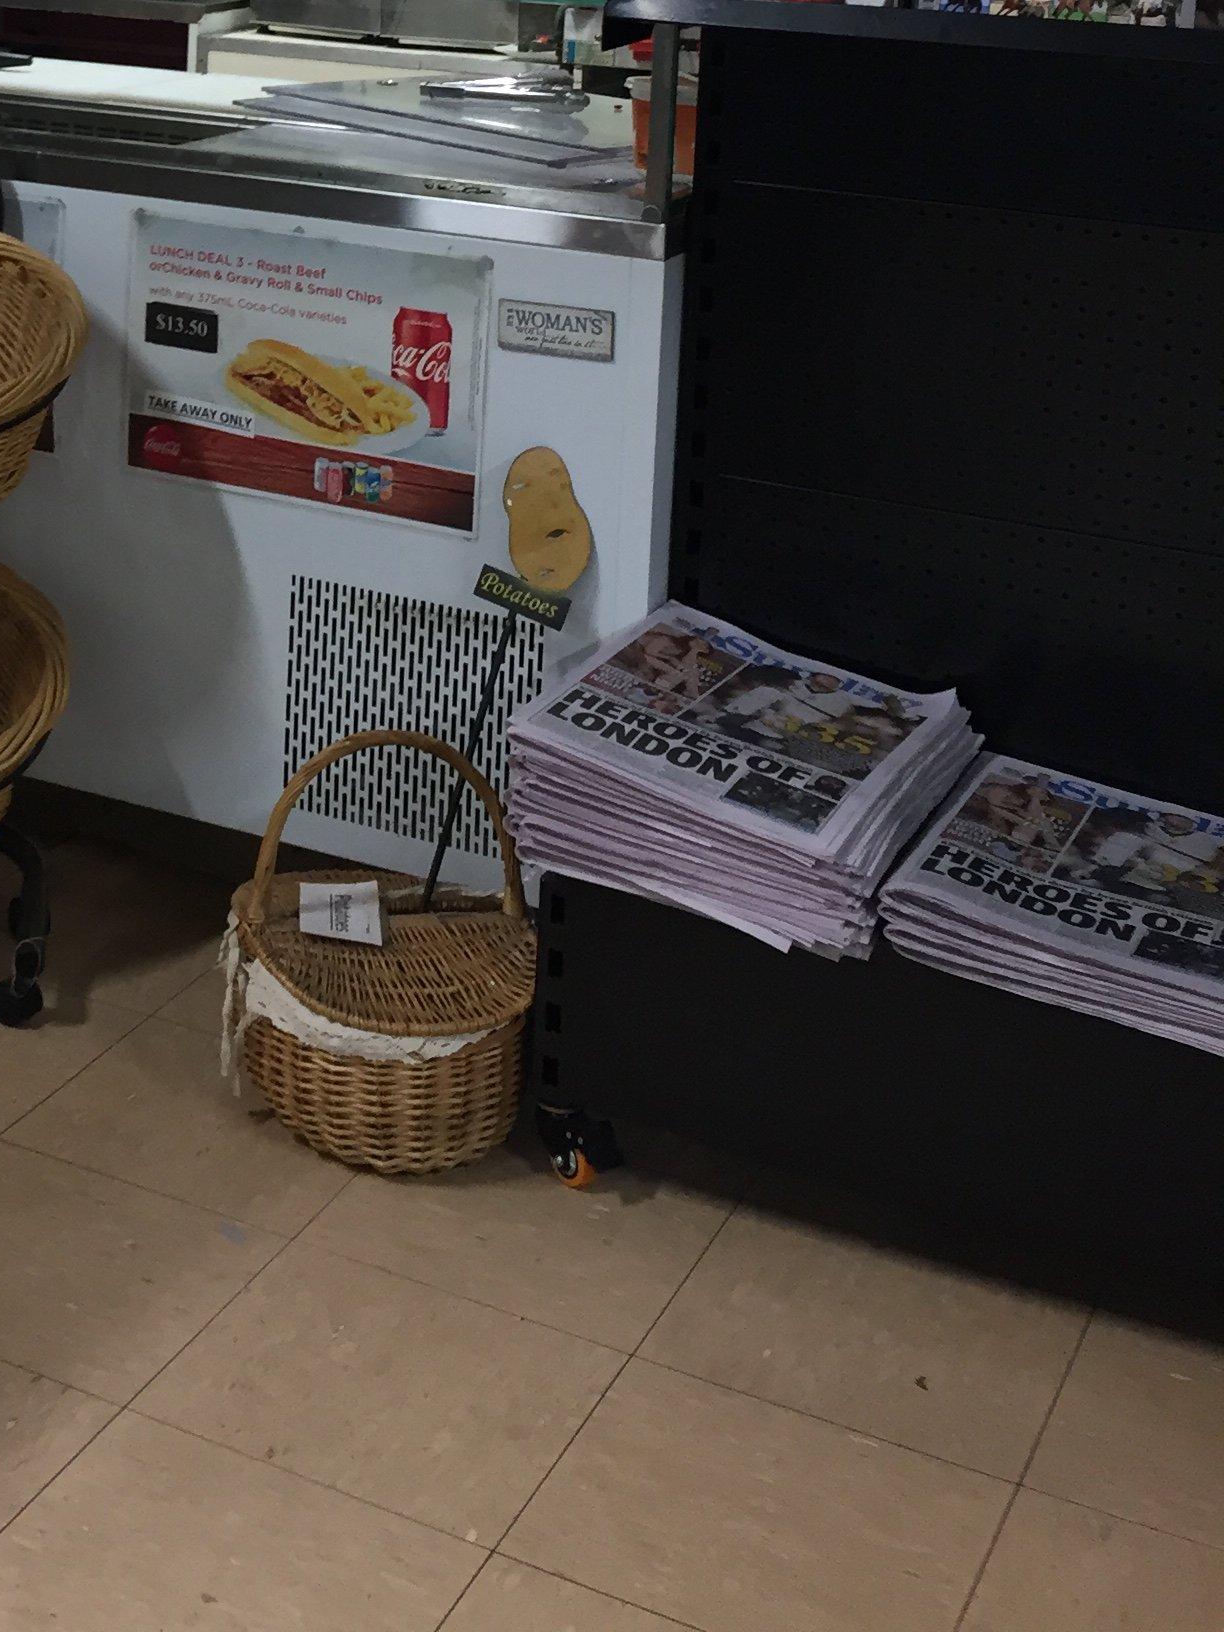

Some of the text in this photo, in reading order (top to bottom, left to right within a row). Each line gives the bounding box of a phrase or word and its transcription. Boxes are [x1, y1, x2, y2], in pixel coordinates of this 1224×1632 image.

[150, 244, 327, 279] LUNCH DEAL Roast Beef
[227, 272, 384, 306] Gravy Roll Small Chips
[155, 313, 208, 337] $13.50
[515, 309, 604, 336] WOMAN'S
[148, 394, 253, 428] TAKE AWAY ONLY
[480, 572, 559, 618] Potatoes
[546, 701, 742, 784] LONDON
[562, 687, 814, 788] HEROES OF
[920, 857, 1137, 943] LONDON
[930, 843, 1214, 939] HEROES OF
